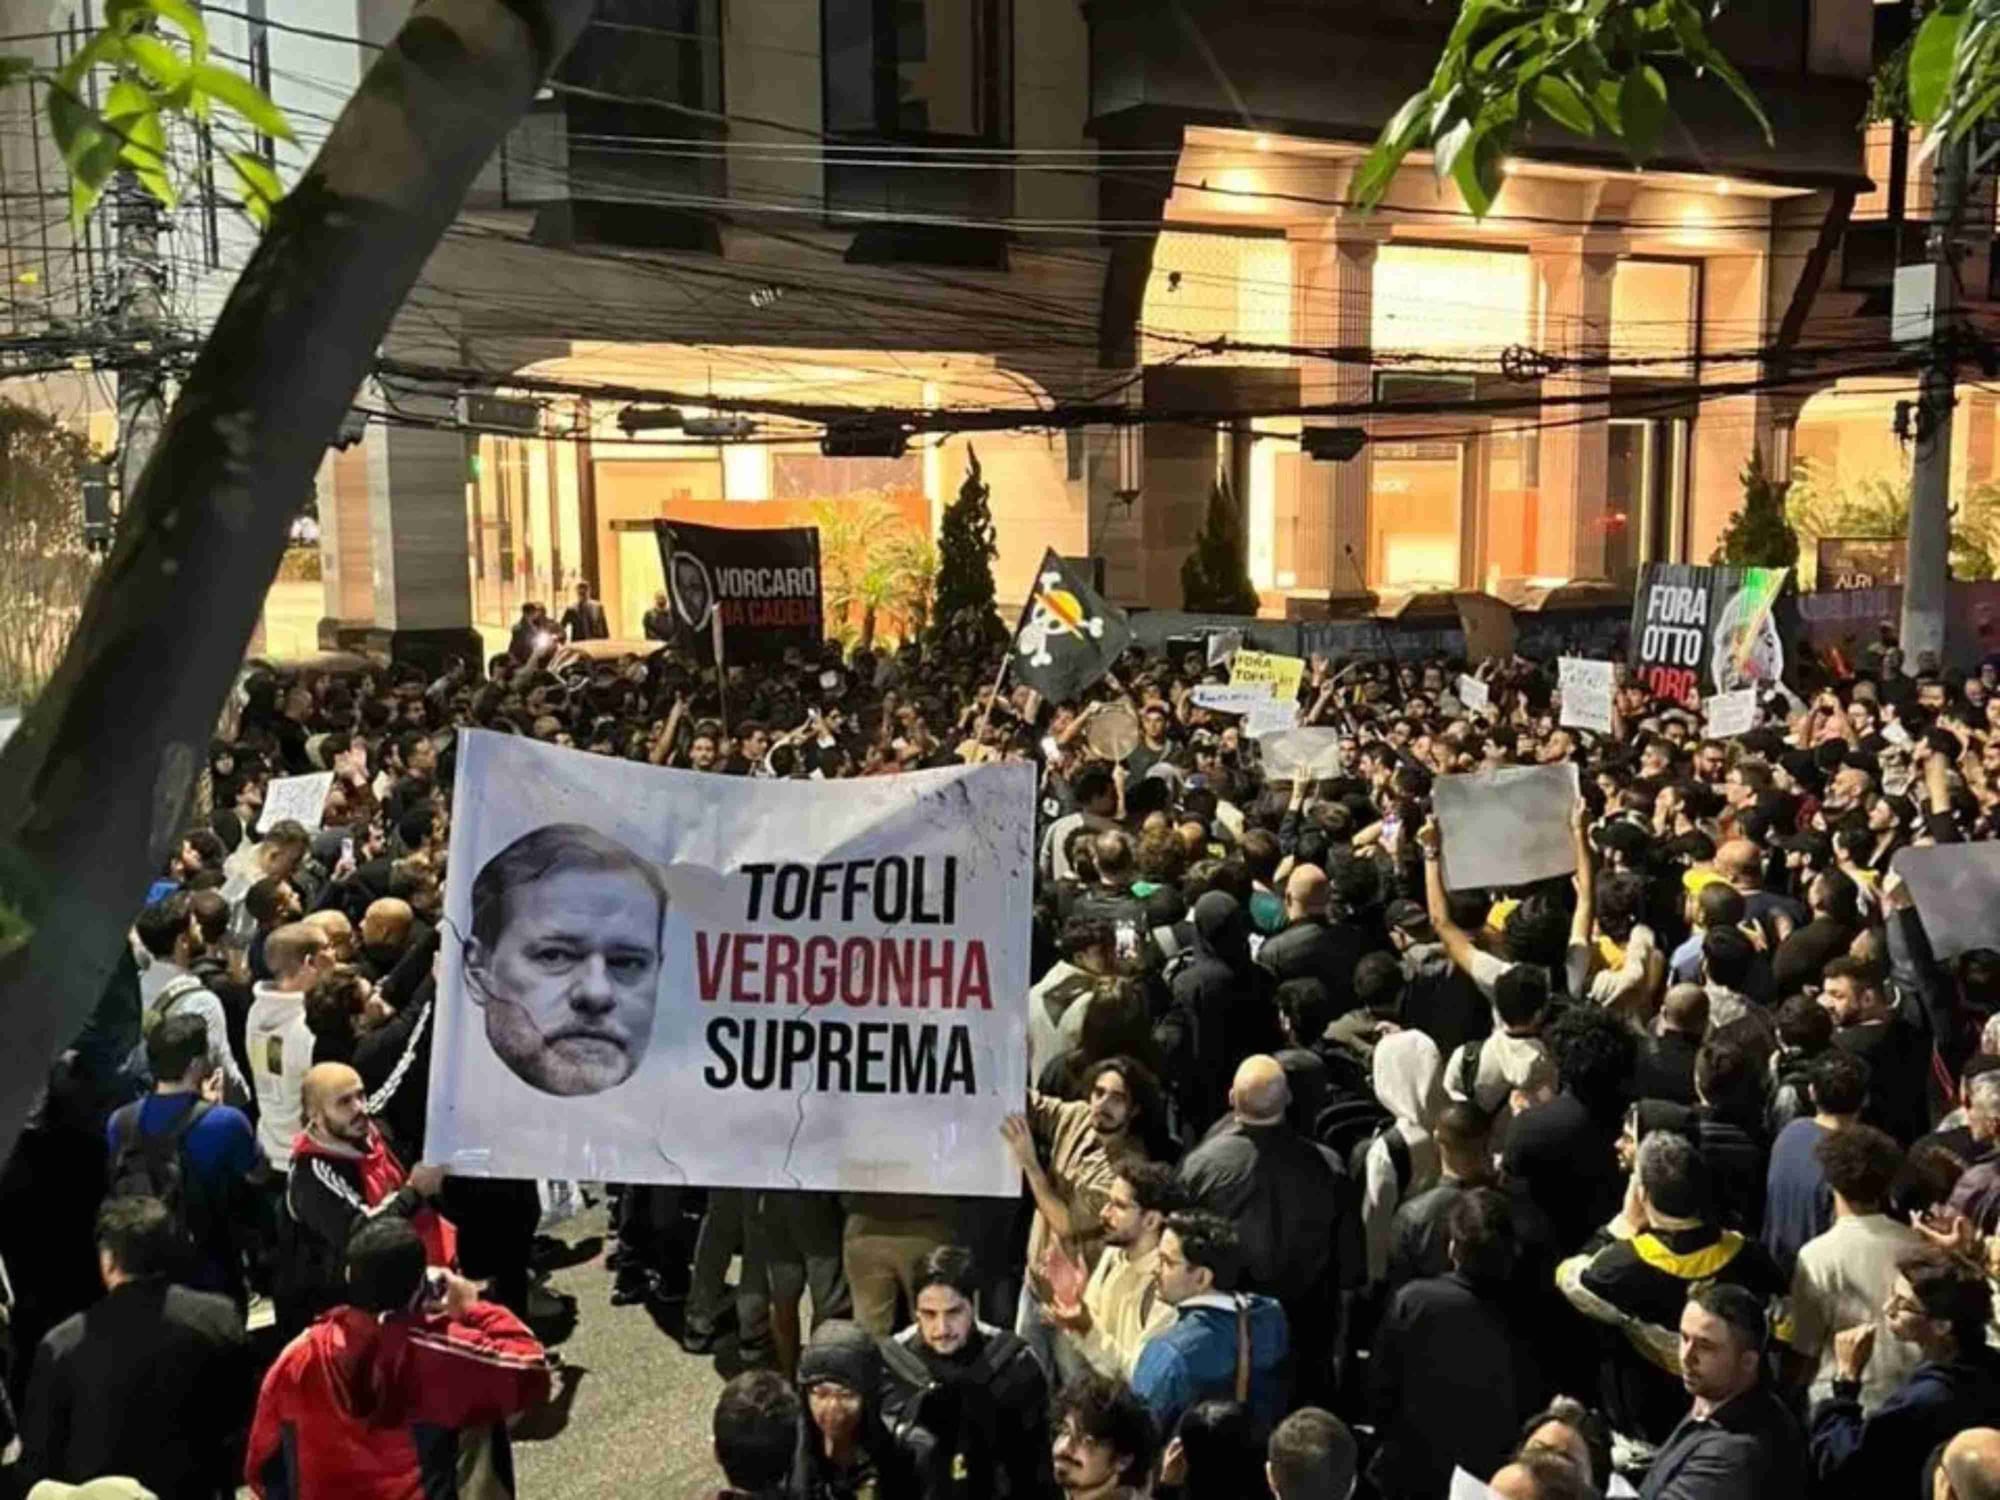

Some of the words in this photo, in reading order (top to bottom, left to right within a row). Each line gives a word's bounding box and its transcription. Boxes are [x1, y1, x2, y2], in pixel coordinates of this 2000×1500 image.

[715, 566, 816, 598] VORCARO
[1647, 585, 1706, 626] FORA
[1641, 624, 1703, 666] OTTO
[740, 855, 957, 925] TOFFOLI
[695, 931, 993, 1011] VERGONHA
[703, 1016, 977, 1096] SUPREMA
